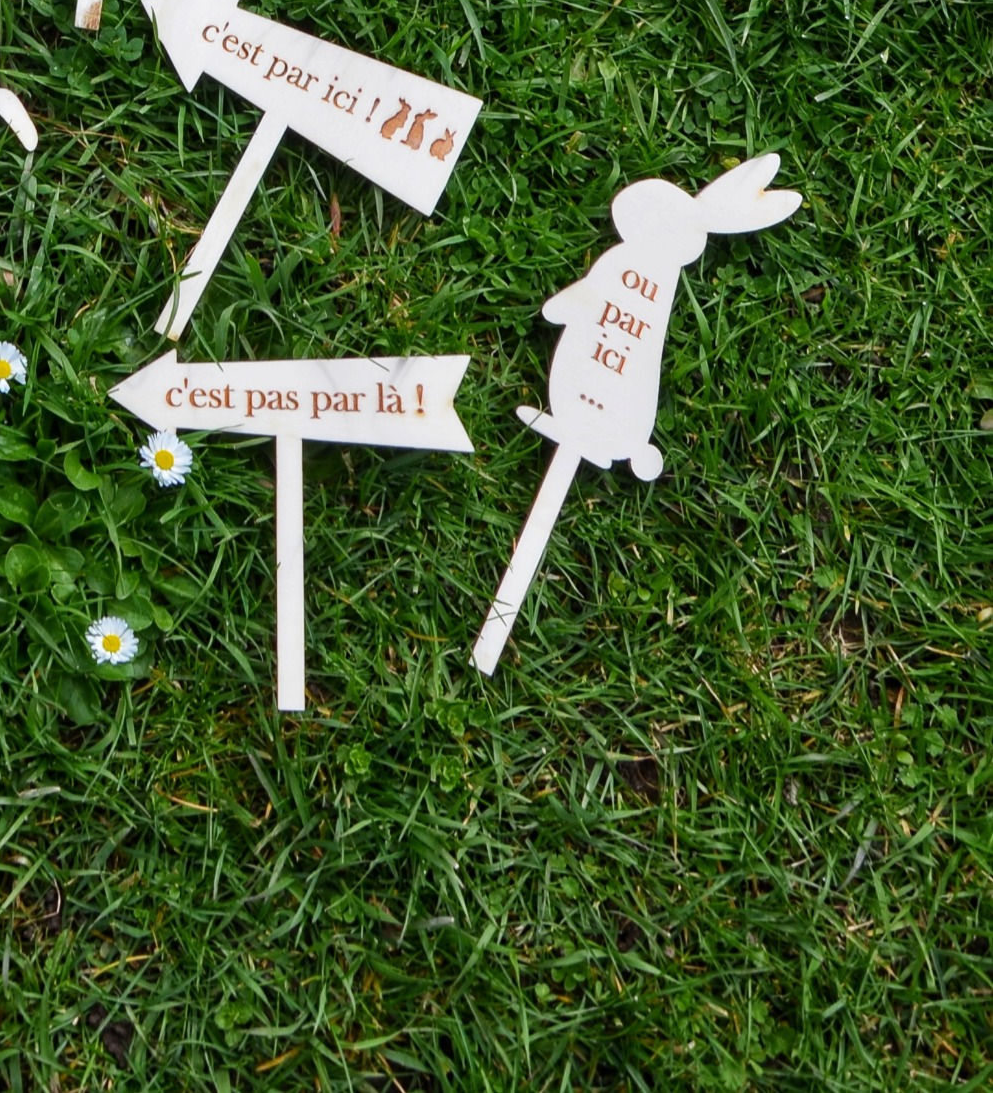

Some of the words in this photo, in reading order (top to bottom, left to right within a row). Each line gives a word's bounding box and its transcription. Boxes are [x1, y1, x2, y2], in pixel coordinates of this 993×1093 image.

[201, 21, 265, 66] c'est
[263, 54, 319, 92] par
[321, 76, 363, 115] ici
[365, 97, 381, 123] !
[621, 269, 659, 303] ou
[596, 300, 652, 340] par
[590, 333, 631, 375] ici
[165, 377, 236, 409] c'est
[244, 388, 300, 418] pas
[309, 389, 366, 420] par
[375, 381, 406, 414] là
[415, 383, 425, 414] !
